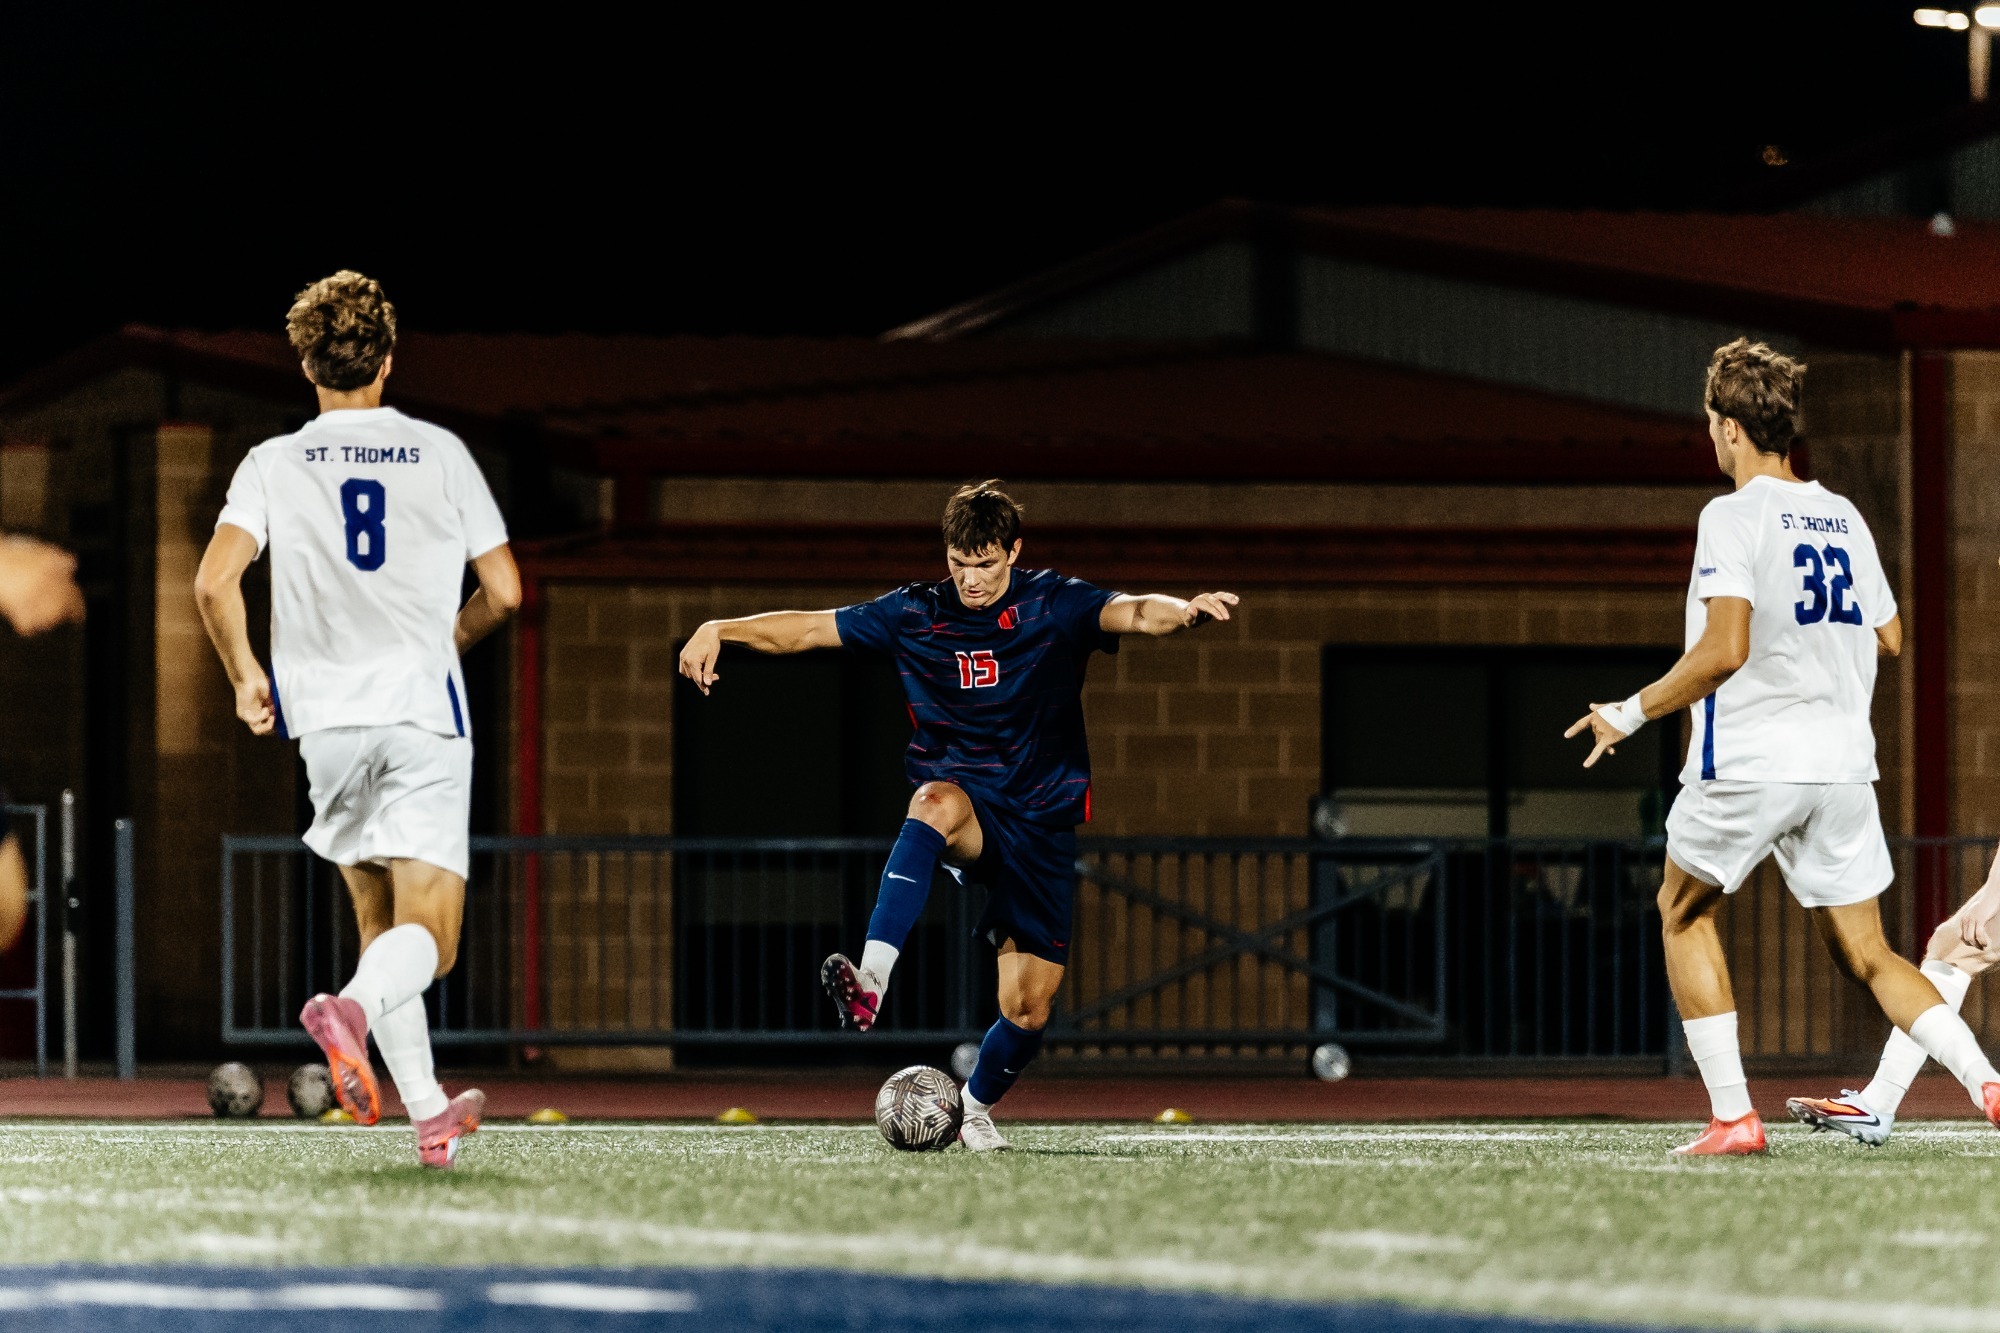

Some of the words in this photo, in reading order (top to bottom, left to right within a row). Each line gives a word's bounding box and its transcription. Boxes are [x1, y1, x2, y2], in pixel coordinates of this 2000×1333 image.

[305, 446, 334, 462] ST.
[340, 446, 420, 464] THOMAS
[340, 477, 386, 572] 8
[1793, 542, 1863, 626] 32
[955, 649, 999, 689] 15
